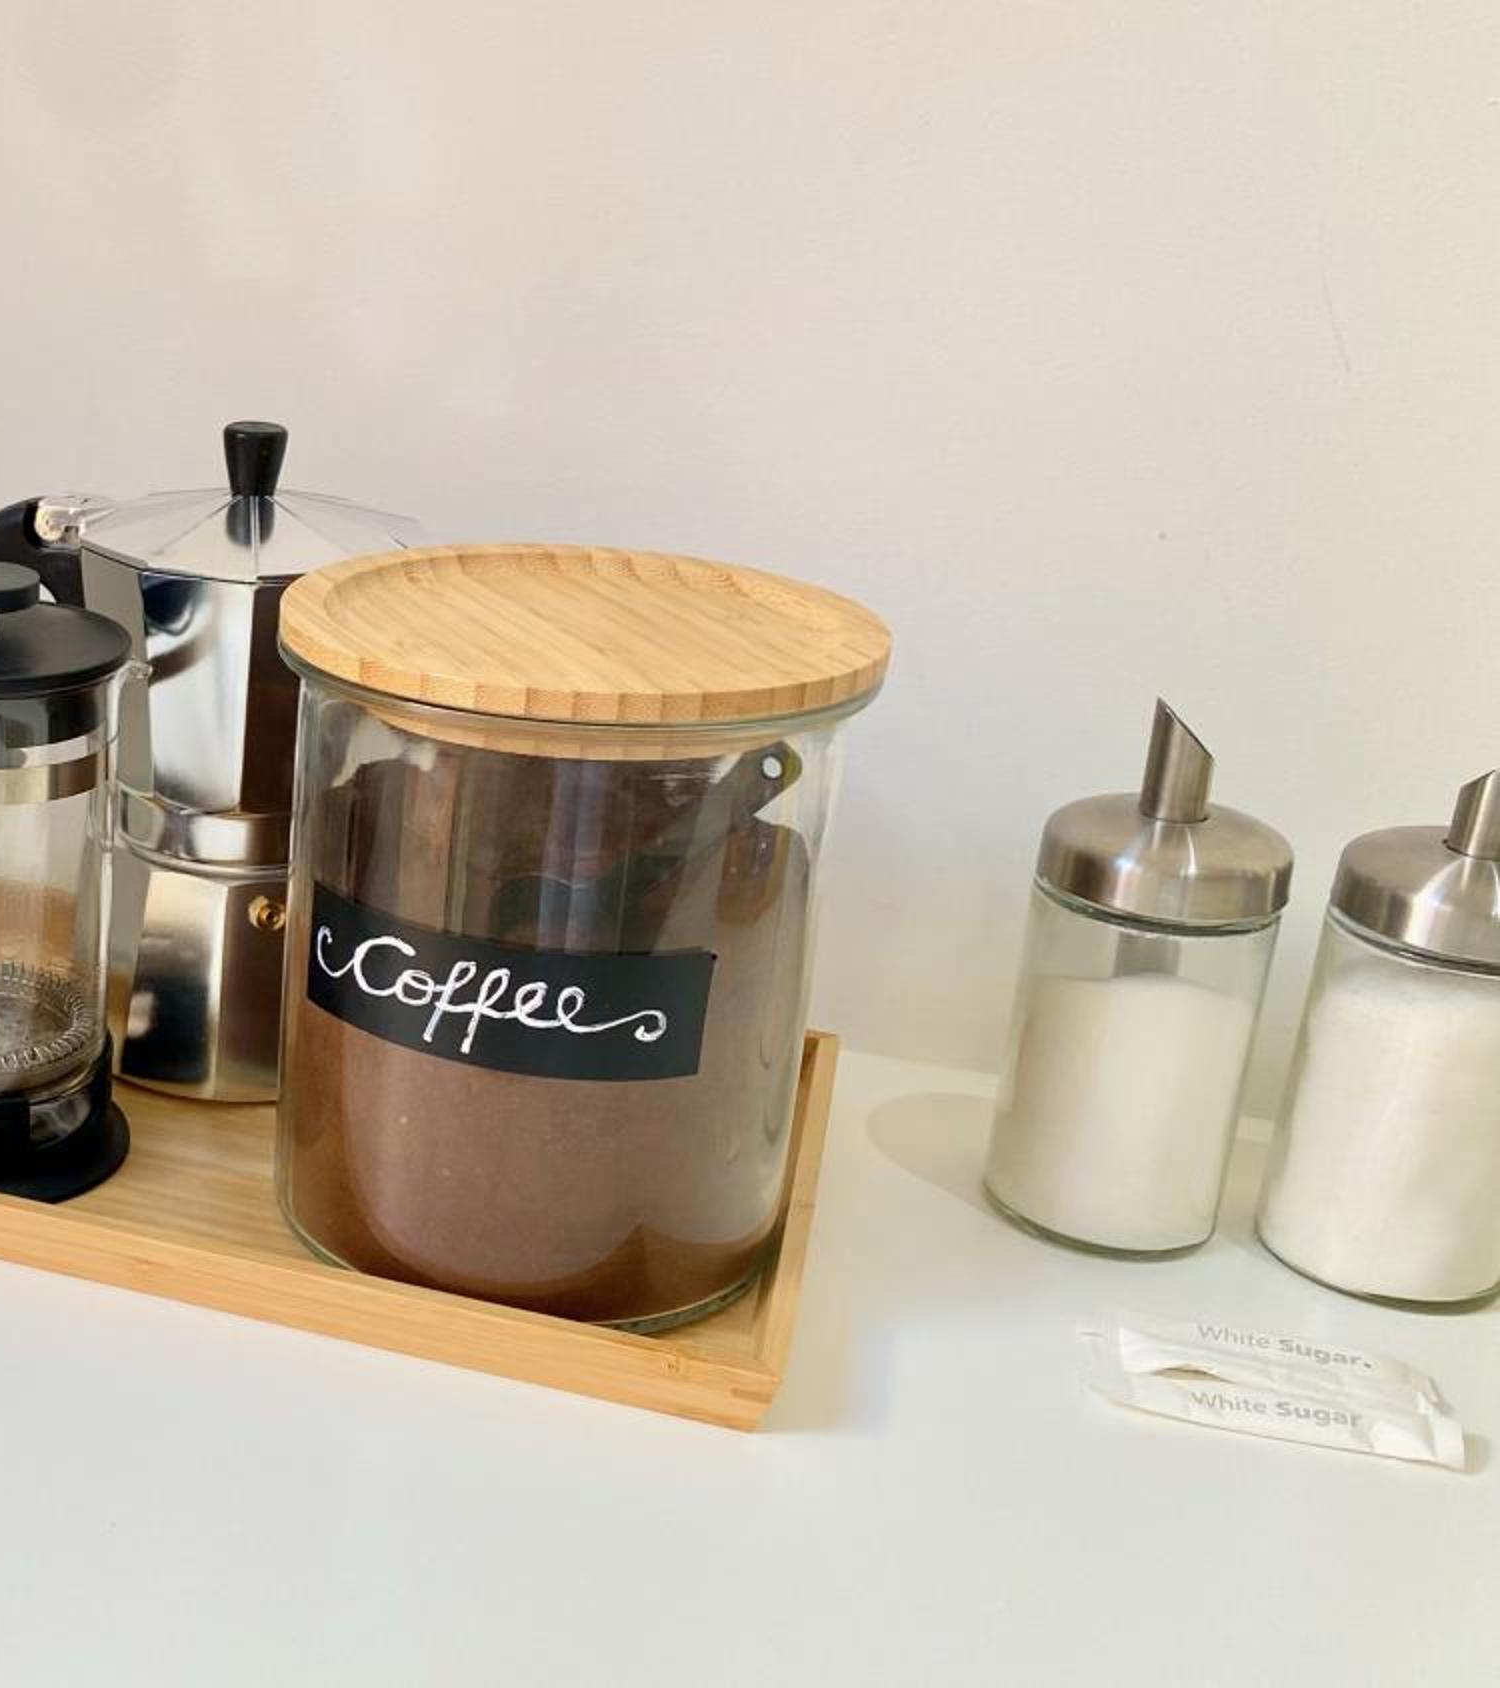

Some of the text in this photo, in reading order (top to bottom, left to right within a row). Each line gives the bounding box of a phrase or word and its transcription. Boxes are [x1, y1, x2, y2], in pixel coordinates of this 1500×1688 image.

[317, 926, 667, 1054] Coffee
[1196, 1323, 1271, 1349] White
[1191, 1391, 1363, 1427] White Sugar
